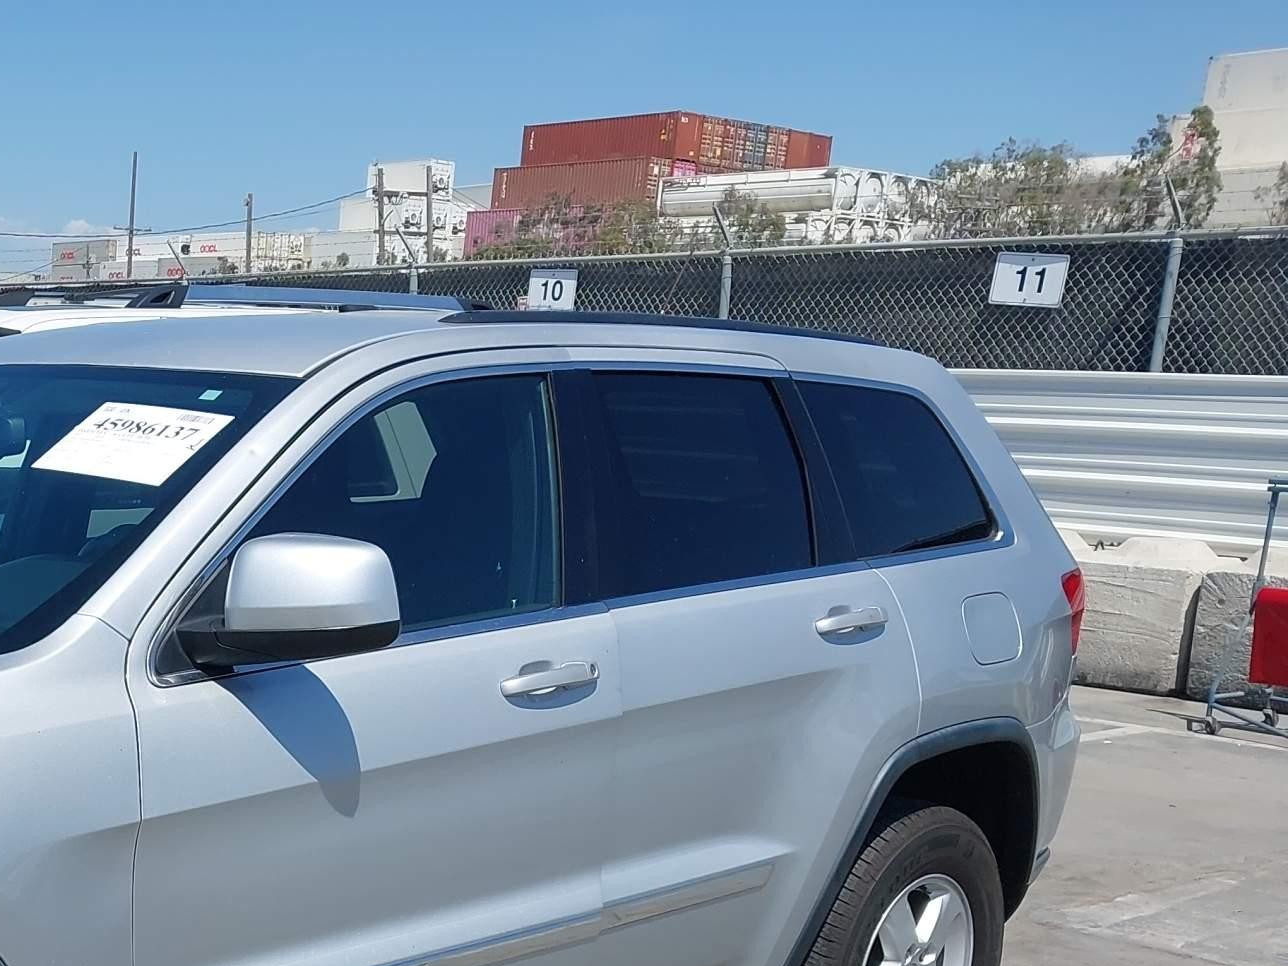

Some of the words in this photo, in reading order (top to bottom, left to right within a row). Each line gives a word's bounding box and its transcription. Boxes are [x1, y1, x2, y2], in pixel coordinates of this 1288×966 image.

[541, 279, 564, 302] 10
[1015, 266, 1047, 294] 11
[93, 417, 201, 441] 45986137
